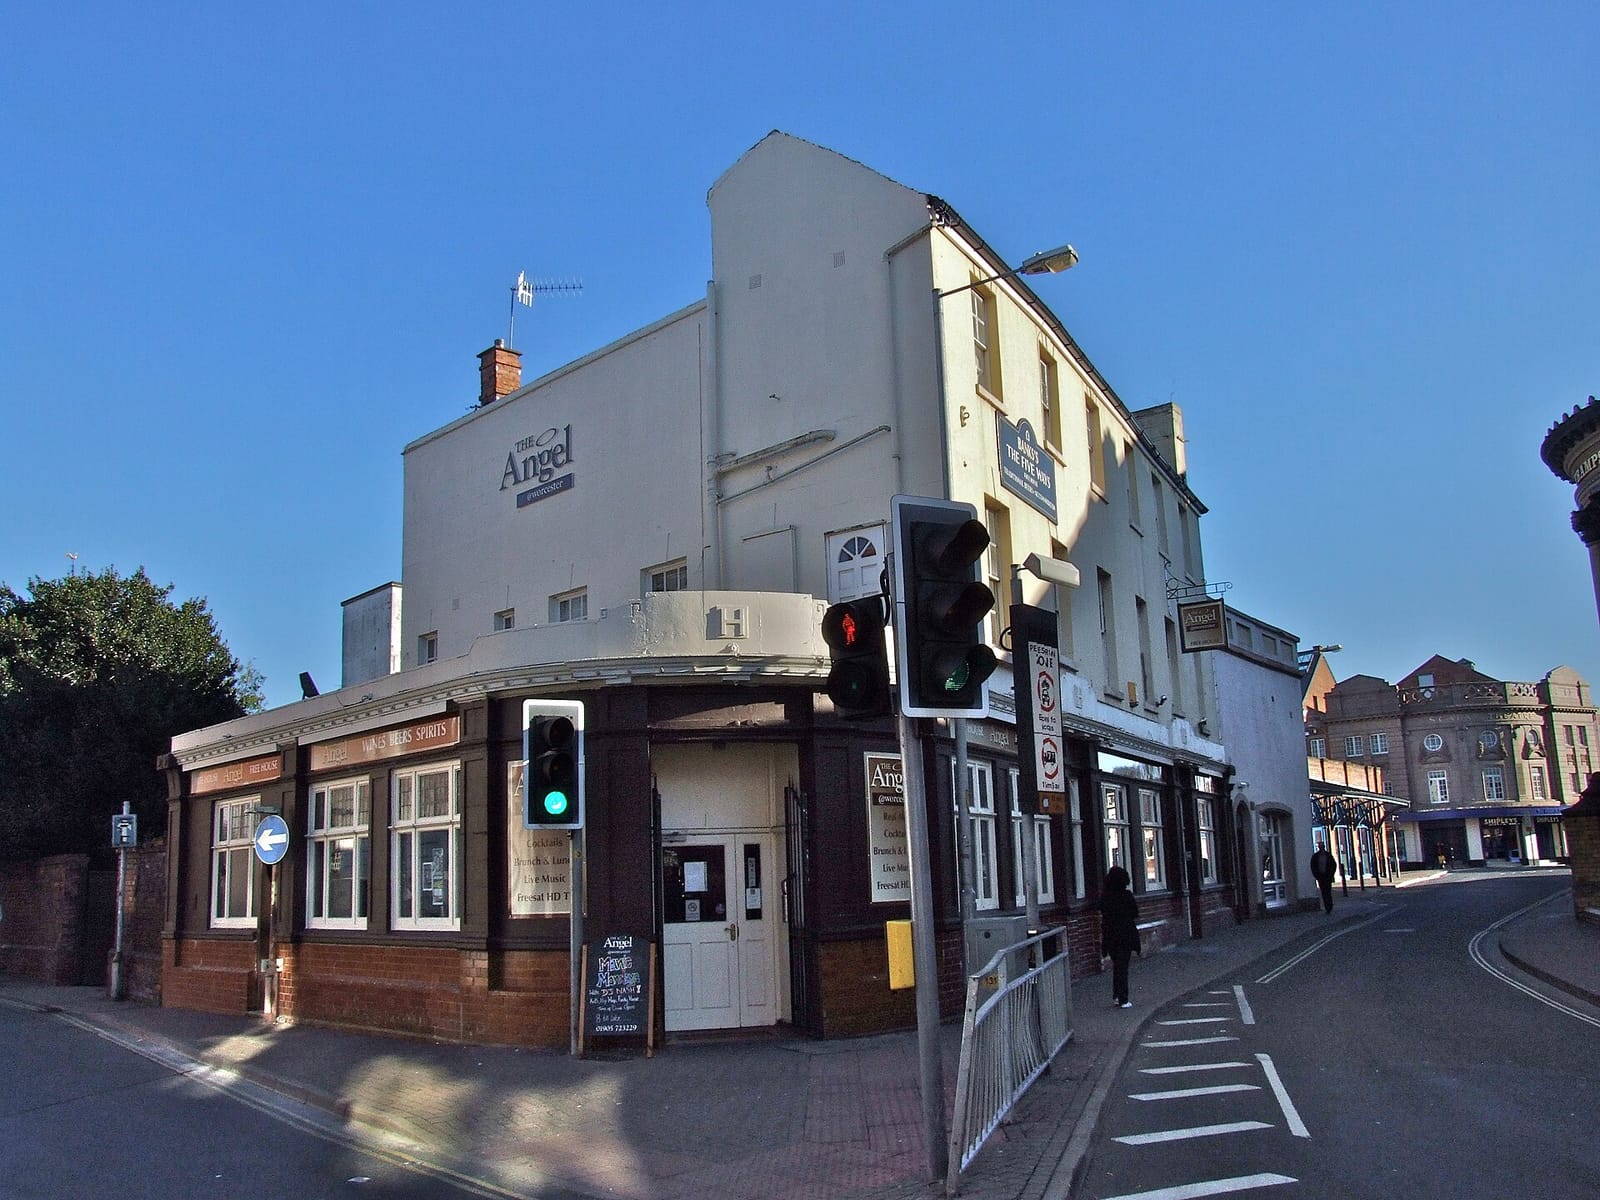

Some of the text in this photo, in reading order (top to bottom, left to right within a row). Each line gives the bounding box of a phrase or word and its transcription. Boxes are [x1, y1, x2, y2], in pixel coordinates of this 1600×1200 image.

[515, 435, 535, 453] THE
[499, 424, 574, 491] Angel
[1006, 444, 1020, 464] THE
[1022, 455, 1035, 476] FIVE
[1035, 466, 1051, 489] WAYS
[1185, 608, 1216, 624] Angel
[362, 722, 447, 752] WINES BEERS SPIRITS
[871, 764, 904, 793] Ang
[884, 828, 906, 839] Cockta
[526, 837, 562, 848] Cocktails
[514, 857, 541, 867] Brunch
[552, 855, 570, 866] Lun
[883, 864, 897, 873] Live
[524, 873, 566, 884] Live Music
[547, 893, 561, 902] HD
[604, 936, 632, 949] Angel
[598, 954, 632, 972] Manic
